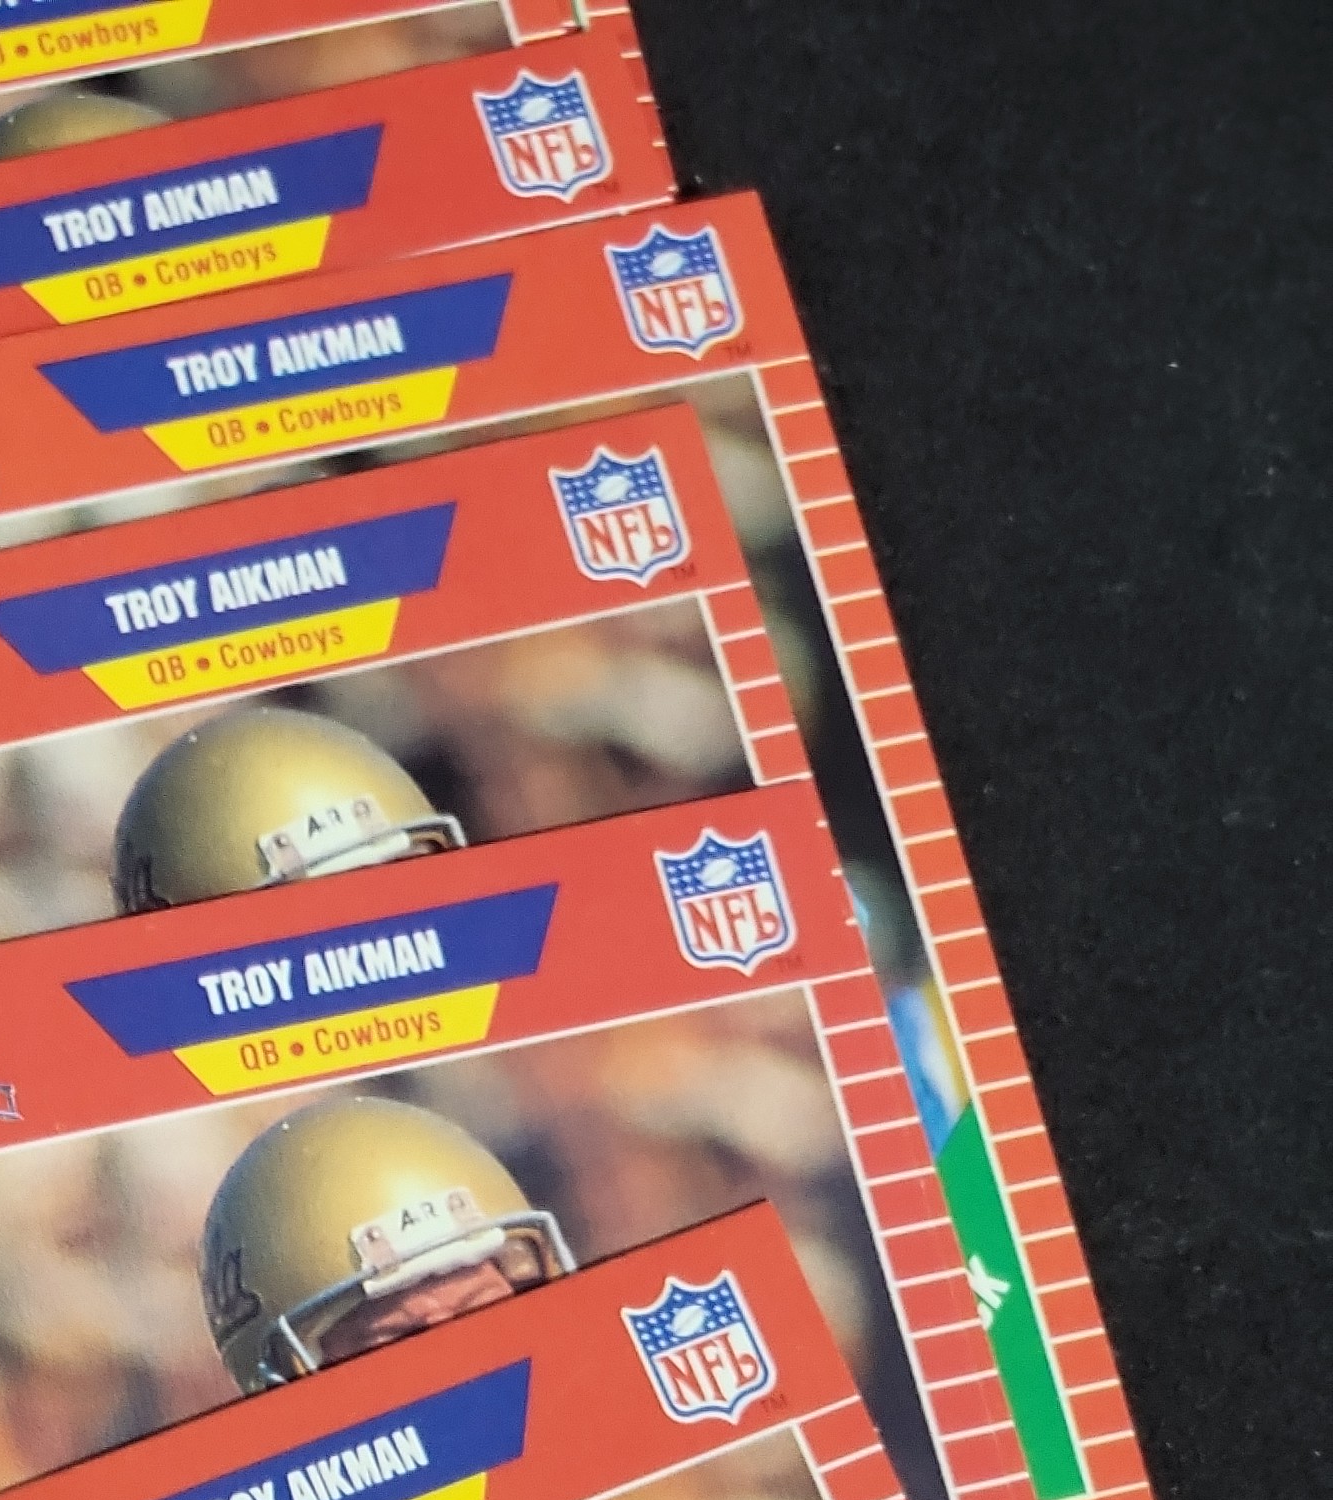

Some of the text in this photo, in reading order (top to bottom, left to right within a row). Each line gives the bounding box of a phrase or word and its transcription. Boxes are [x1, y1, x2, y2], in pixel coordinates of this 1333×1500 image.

[37, 17, 160, 57] Cowboys
[502, 124, 597, 183] NFL
[43, 167, 278, 252] TROY AIKMAN
[85, 239, 279, 301] QB Cowboys
[632, 280, 727, 340] NFL
[166, 315, 404, 395] TROY AIKMAN
[207, 391, 403, 448] QB Cowboys
[580, 503, 674, 564] NFL
[105, 546, 347, 636] TROY AIKMAN
[146, 626, 343, 685] QB Cowboys
[684, 893, 780, 954] NFL
[198, 928, 445, 1016] TROY AIKMAN
[239, 1011, 441, 1071] QB Cowboys
[661, 1331, 760, 1406] NFL
